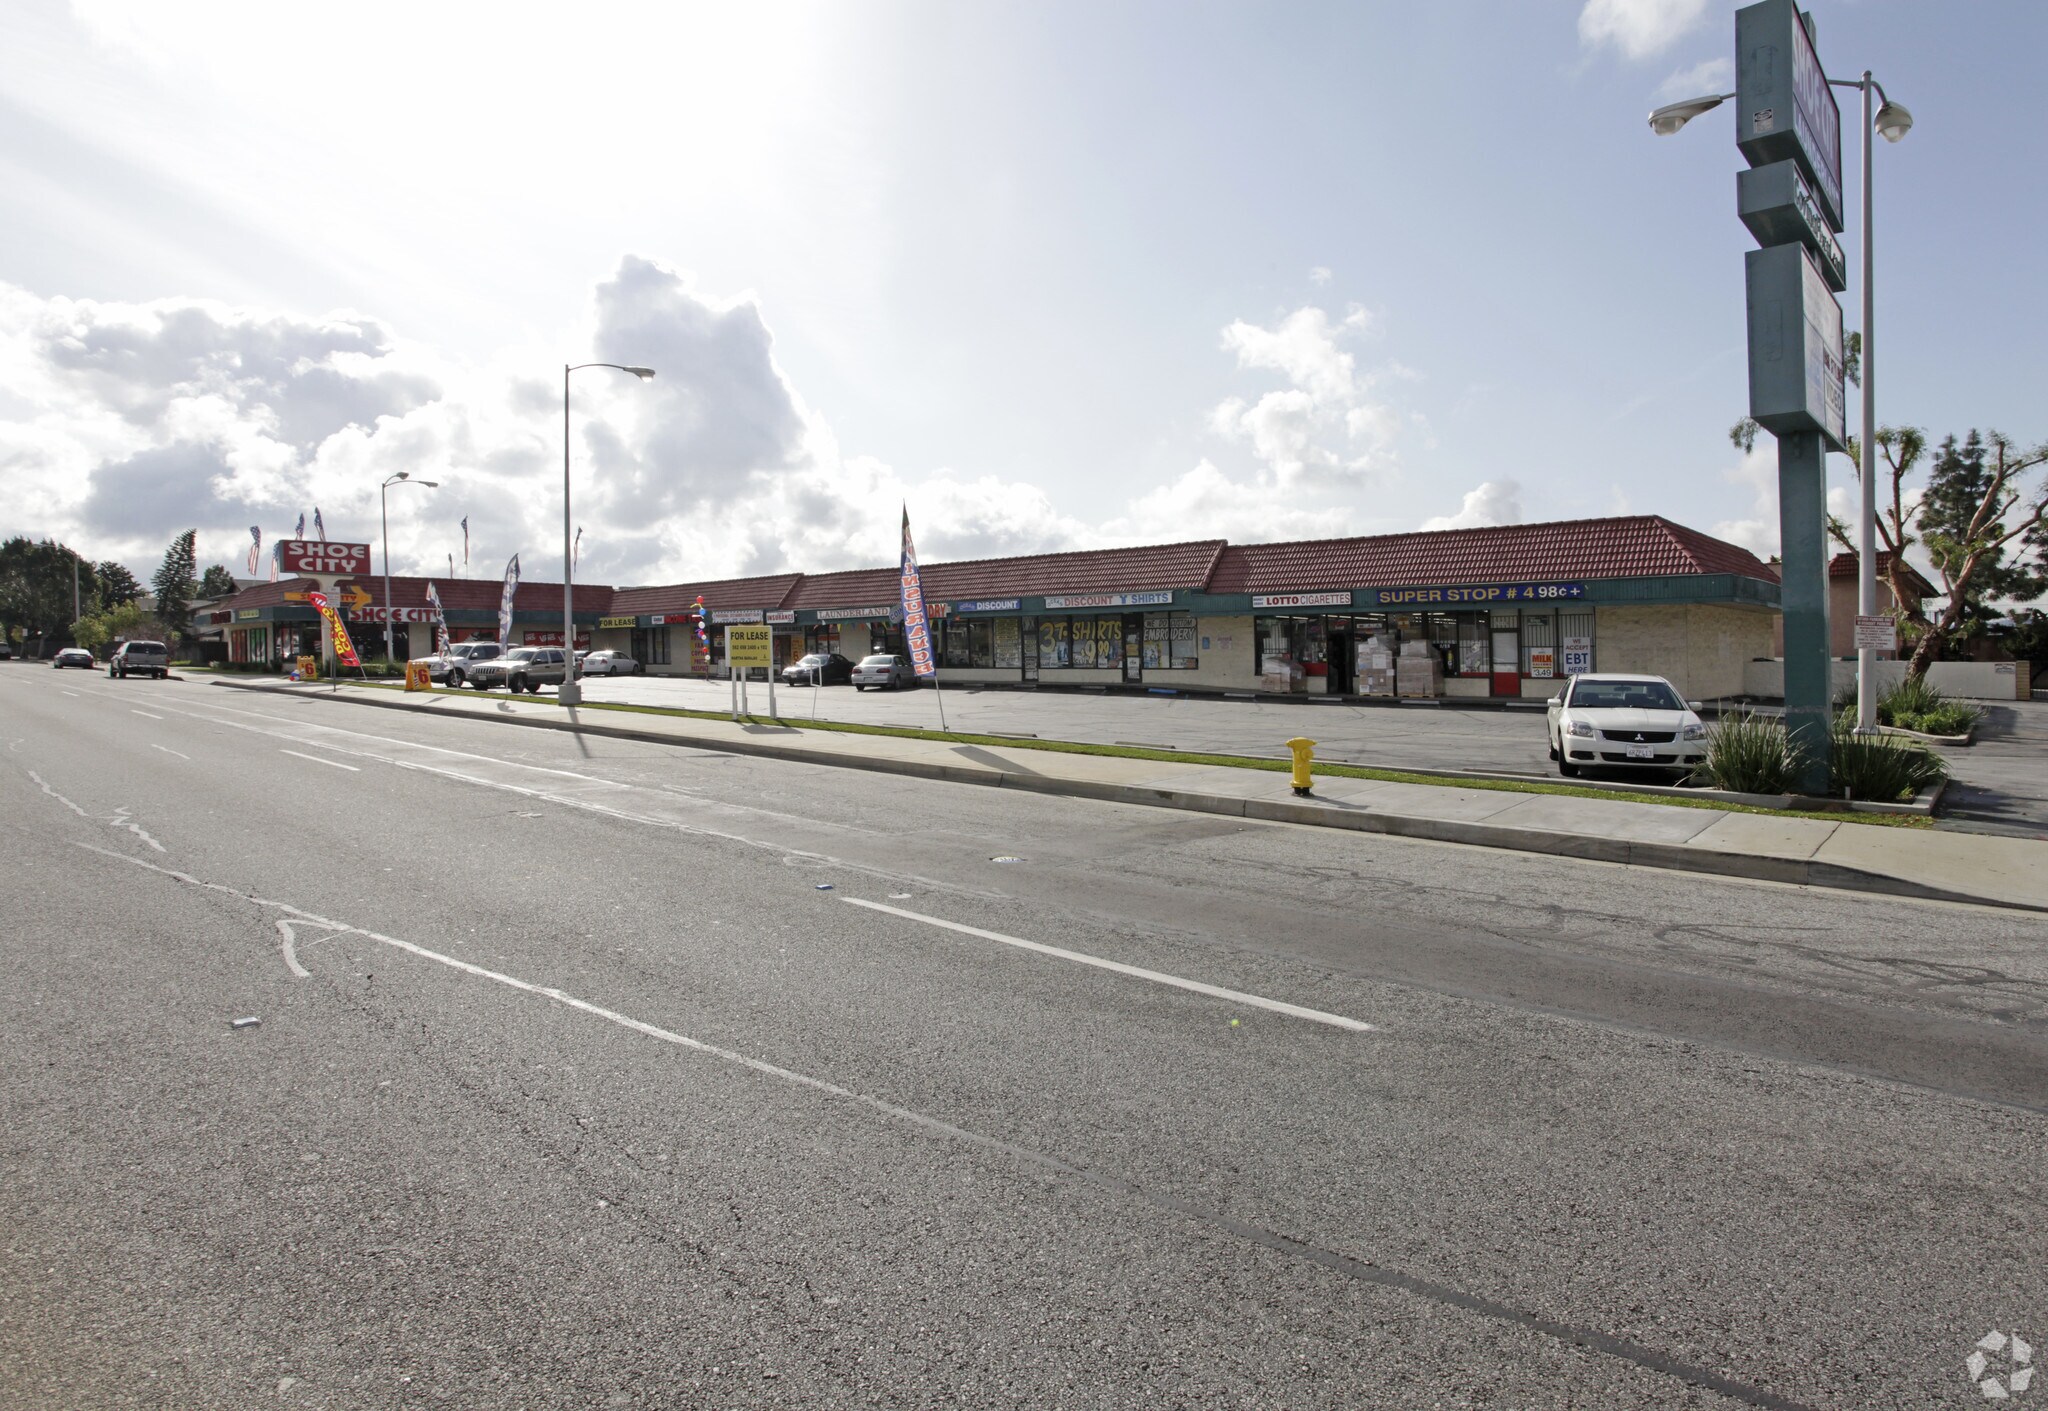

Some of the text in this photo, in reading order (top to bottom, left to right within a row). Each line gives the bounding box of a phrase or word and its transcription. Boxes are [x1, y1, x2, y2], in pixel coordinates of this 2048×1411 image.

[288, 542, 365, 558] SHOE
[299, 557, 357, 572] CITY
[1064, 595, 1113, 607] DISCOUNT
[1131, 592, 1169, 604] SHIRTS
[1266, 593, 1350, 605] LOTTO CIGARETTES
[1379, 590, 1442, 603] SUPER
[1447, 588, 1500, 601] STOP
[1506, 588, 1518, 599] #
[1523, 586, 1534, 598] 4
[976, 600, 1018, 610] DISCOUNT
[350, 607, 402, 622] SHOE
[818, 607, 889, 620] LAUNDERLAND
[600, 618, 636, 627] FOR LEASE
[730, 632, 769, 640] FOR LEASE
[1144, 628, 1195, 641] EMBROIDERY
[1532, 655, 1552, 663] MILK
[1566, 653, 1588, 664] EBT
